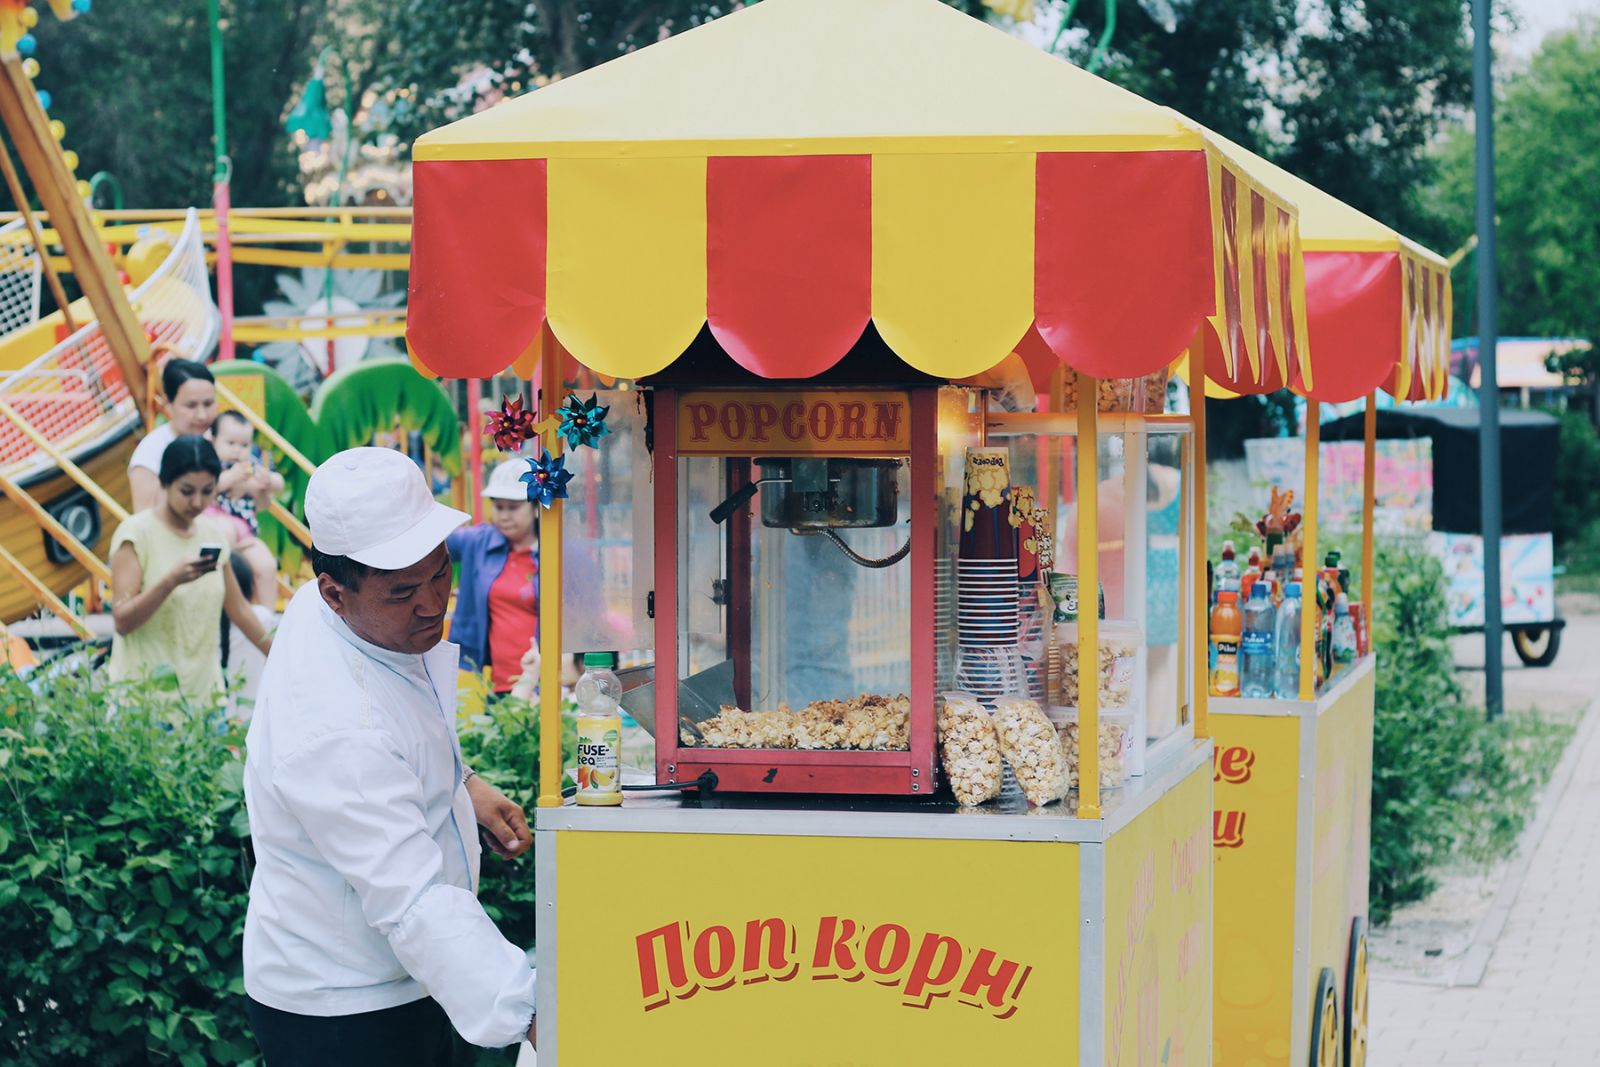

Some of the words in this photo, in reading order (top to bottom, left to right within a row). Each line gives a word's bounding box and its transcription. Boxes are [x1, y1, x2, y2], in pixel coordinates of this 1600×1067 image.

[685, 400, 904, 443] POPCORN
[577, 755, 597, 766] tea
[636, 916, 799, 1012] Поп
[812, 915, 1032, 1020] корн
